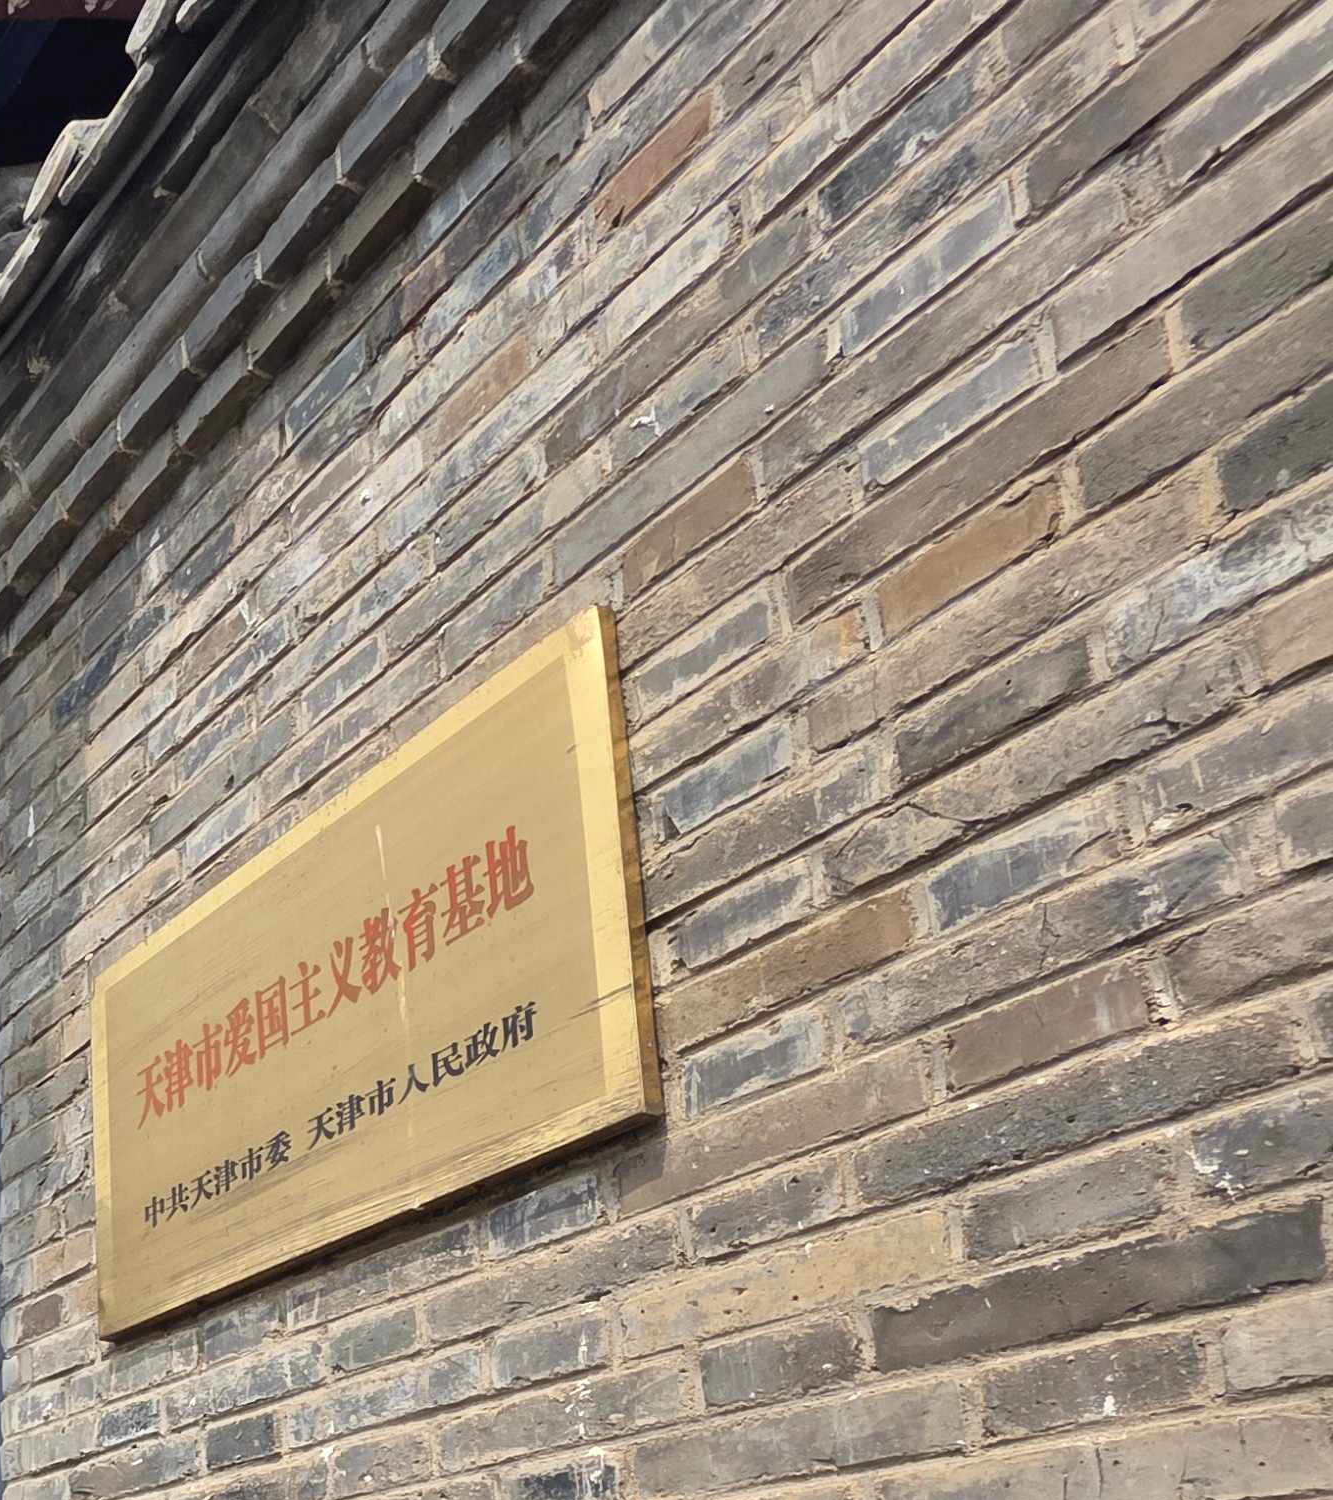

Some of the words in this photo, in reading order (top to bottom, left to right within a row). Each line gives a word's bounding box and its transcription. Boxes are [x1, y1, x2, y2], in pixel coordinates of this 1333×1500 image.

[137, 825, 535, 1129] 天津市爱国主义教育基地
[144, 1130, 291, 1228] 中共天津市委
[307, 1001, 538, 1149] 天津市人民政府
